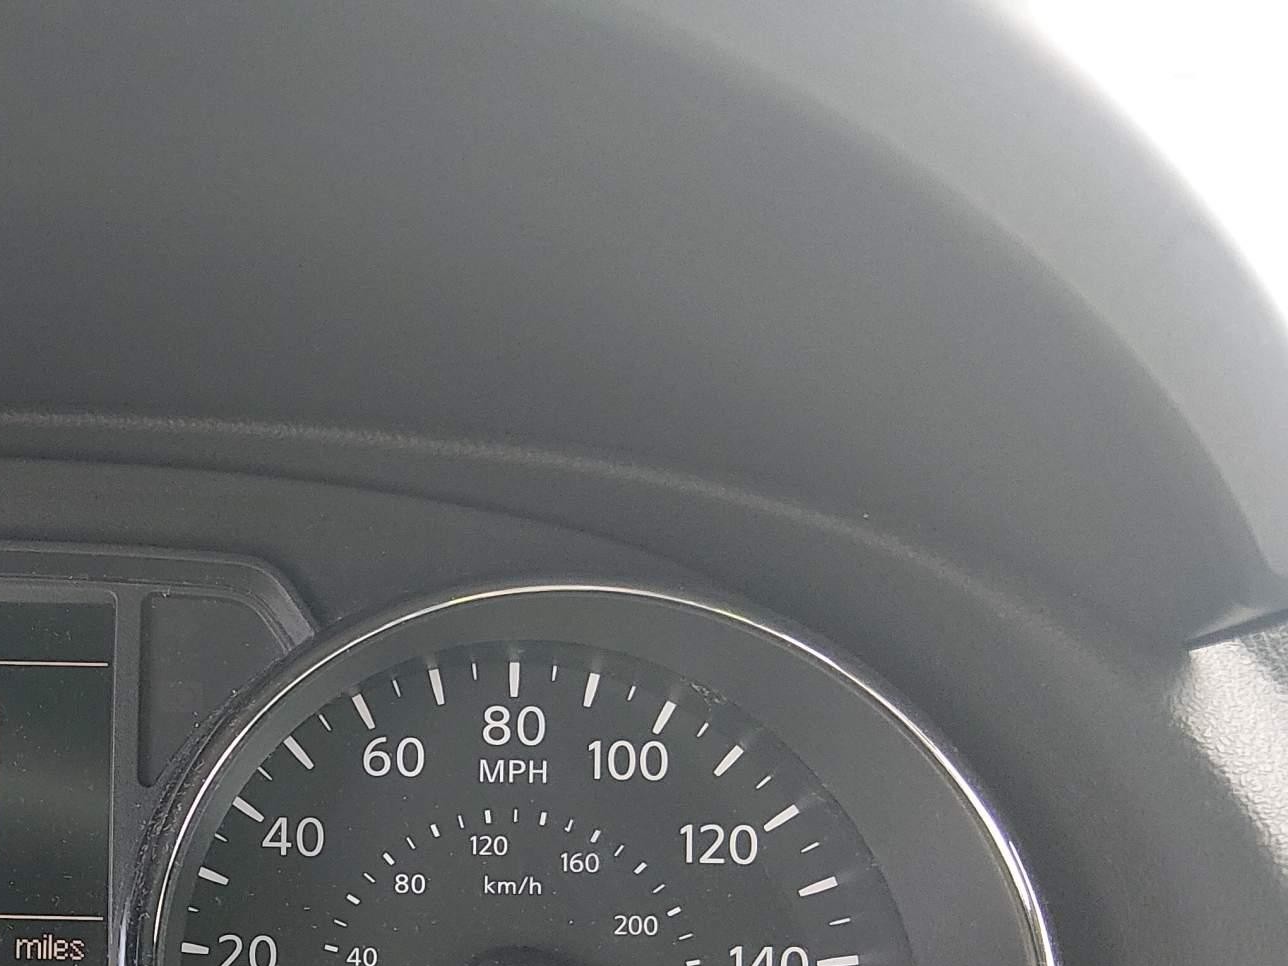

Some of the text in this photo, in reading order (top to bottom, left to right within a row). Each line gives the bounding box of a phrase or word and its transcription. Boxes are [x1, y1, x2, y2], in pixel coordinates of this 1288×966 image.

[482, 705, 546, 746] 80
[363, 736, 425, 777] 60
[588, 740, 668, 781] 100
[479, 759, 547, 784] MPH
[261, 816, 324, 856] 40
[470, 835, 508, 856] 120
[680, 824, 758, 865] 120
[560, 852, 600, 873] 160
[394, 873, 426, 894] 80
[484, 875, 542, 895] km/h
[614, 915, 658, 936] 200
[16, 934, 85, 961] miles
